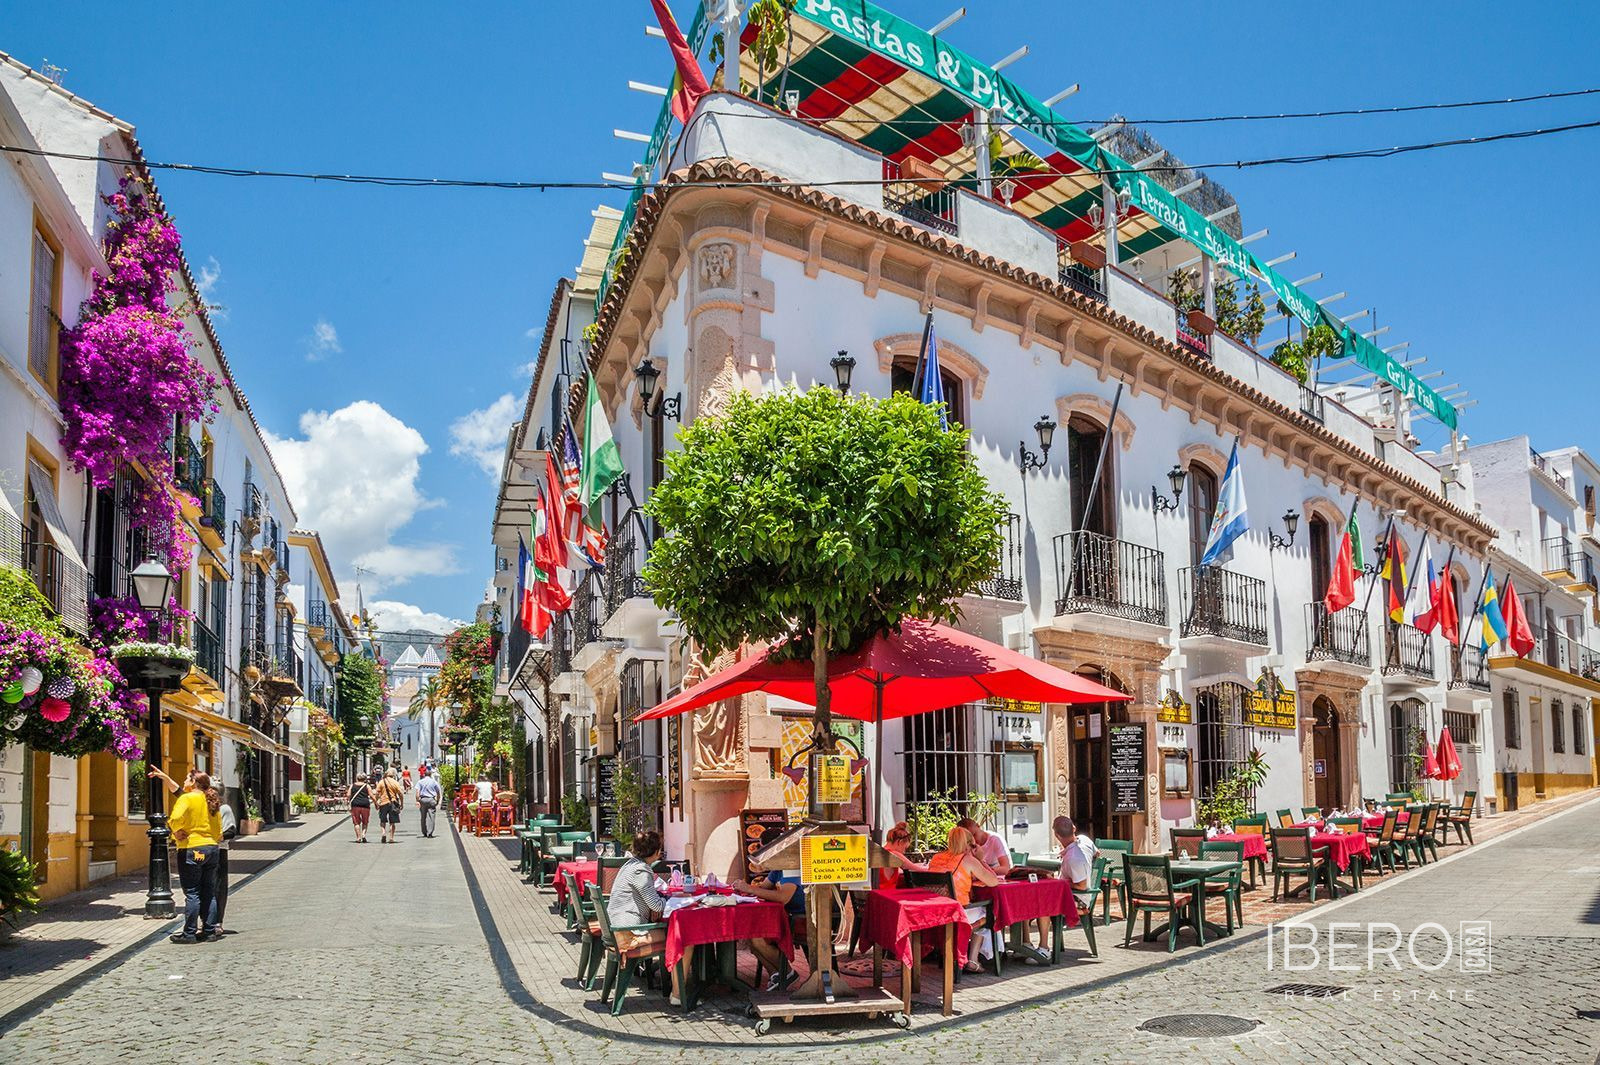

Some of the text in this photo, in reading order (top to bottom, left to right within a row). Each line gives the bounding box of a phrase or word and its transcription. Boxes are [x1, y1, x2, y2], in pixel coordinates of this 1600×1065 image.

[804, 0, 1058, 148] Pastas & Pizzas
[1137, 178, 1188, 235] Terraza
[1386, 361, 1407, 392] Grill
[1417, 384, 1436, 413] Fish
[997, 716, 1032, 728] PIZZA
